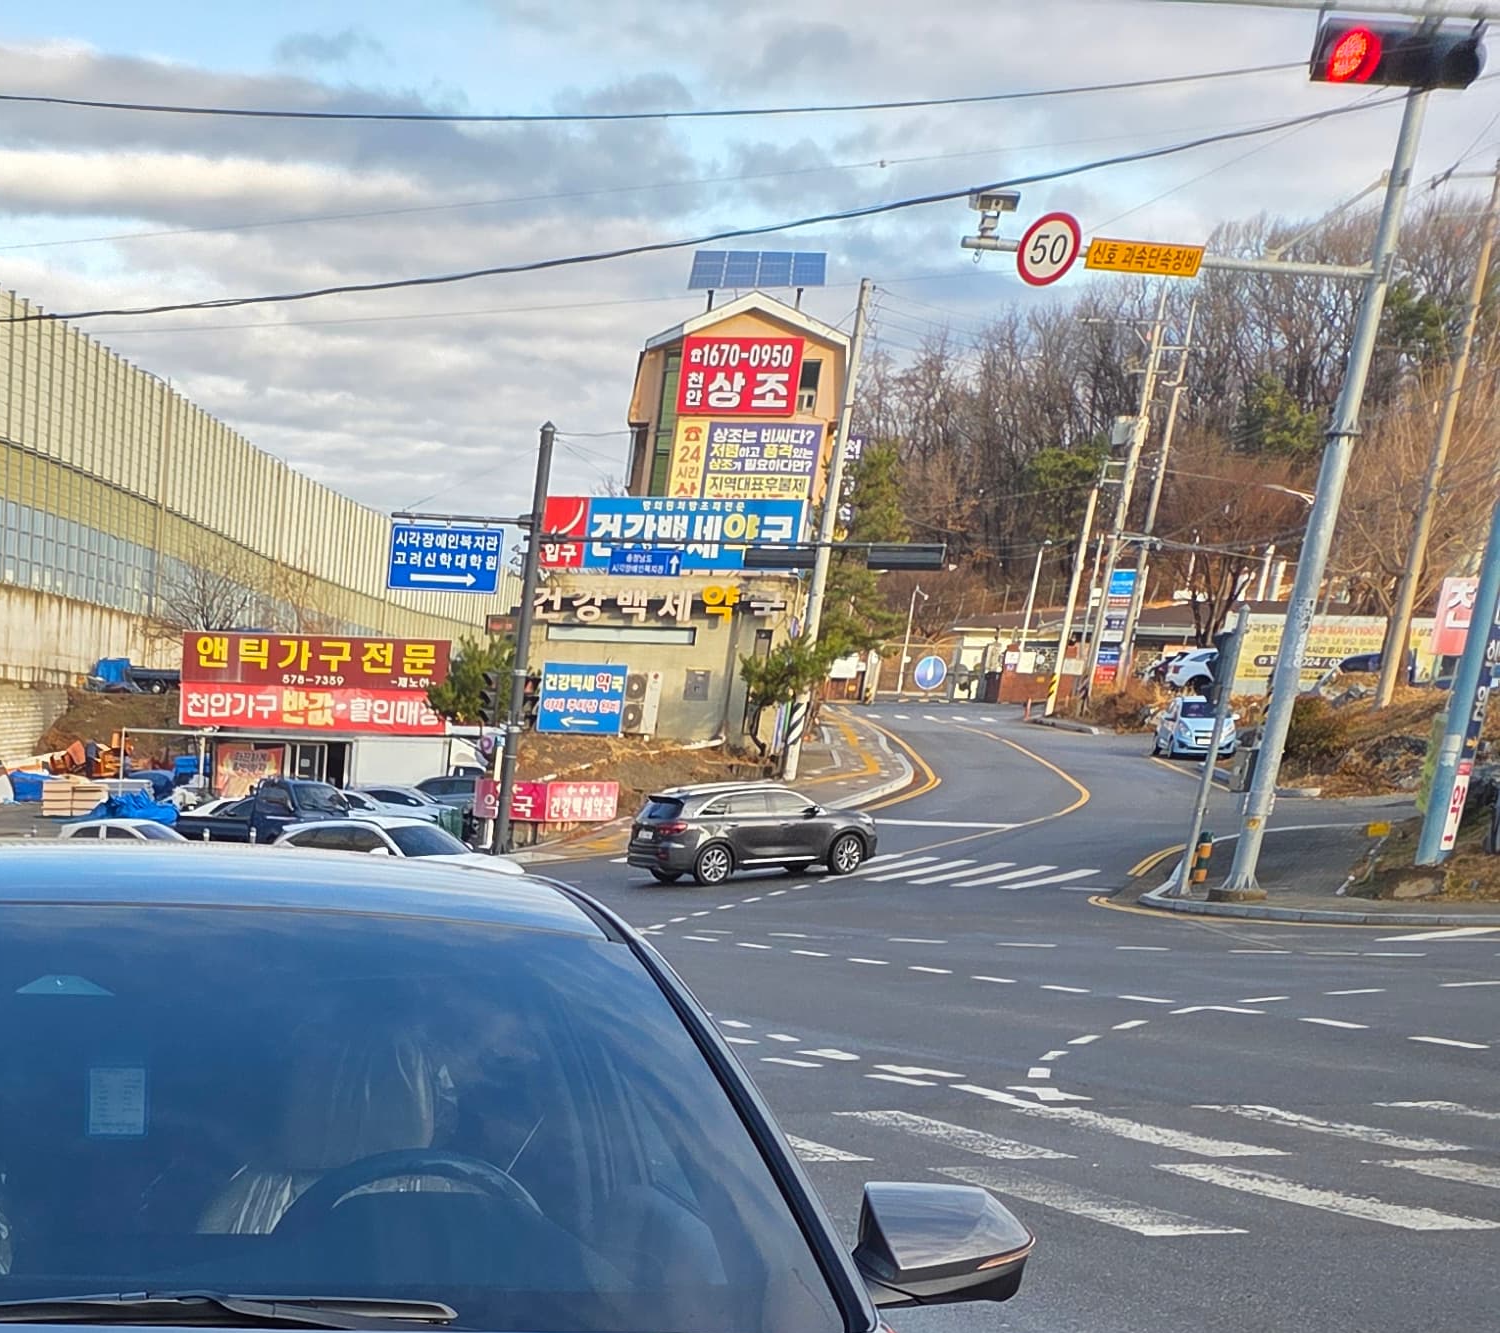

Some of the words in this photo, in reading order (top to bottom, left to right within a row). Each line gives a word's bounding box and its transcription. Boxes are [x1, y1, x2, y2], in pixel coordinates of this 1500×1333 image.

[1030, 234, 1068, 265] 50
[1093, 245, 1119, 265] 신호
[1122, 247, 1199, 273] 과속단속장비
[702, 344, 793, 367] 1670-0950
[685, 372, 705, 406] 천안
[708, 372, 790, 408] 상조
[760, 429, 815, 444] 비싸다?
[679, 446, 700, 463] 24
[676, 467, 699, 479] 시간
[396, 531, 498, 551] 시각장애인복지관
[393, 551, 498, 571] 고려신학대학원
[545, 544, 577, 562] 입구
[197, 636, 437, 675] 앤틱가구전문
[282, 674, 345, 686] 578-7359
[187, 692, 277, 718] 천안가구
